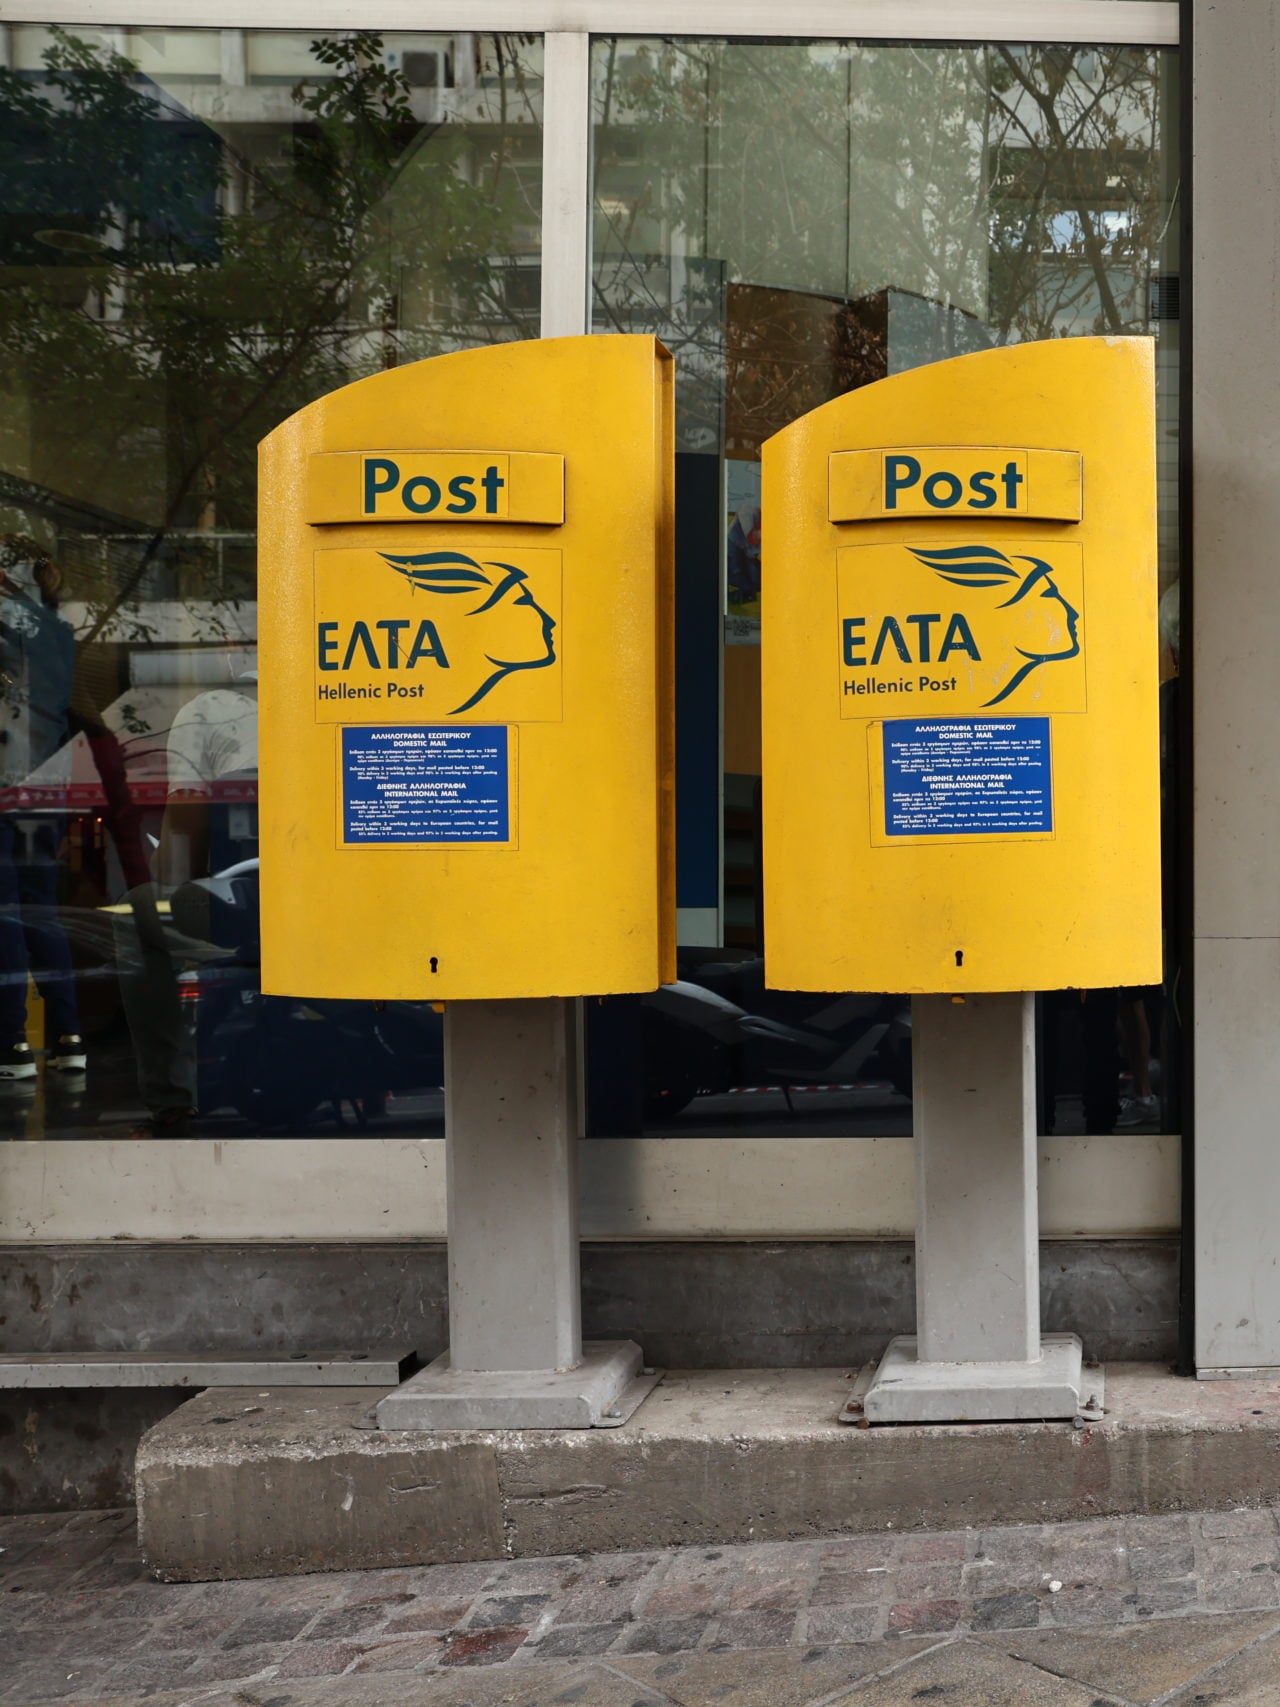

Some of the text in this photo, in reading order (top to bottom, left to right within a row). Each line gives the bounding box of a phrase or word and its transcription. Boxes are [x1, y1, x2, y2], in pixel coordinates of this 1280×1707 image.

[364, 458, 505, 514] Post
[885, 455, 1023, 510] Post
[318, 619, 450, 671] ΕΛΤΑ
[842, 613, 982, 667] ΕΛΤΑ
[318, 682, 425, 700] Hellenic Post
[844, 676, 957, 695] Hellenic Post
[384, 790, 439, 798] INTERNATIONAL
[929, 782, 986, 790] INTERNATIONAL
